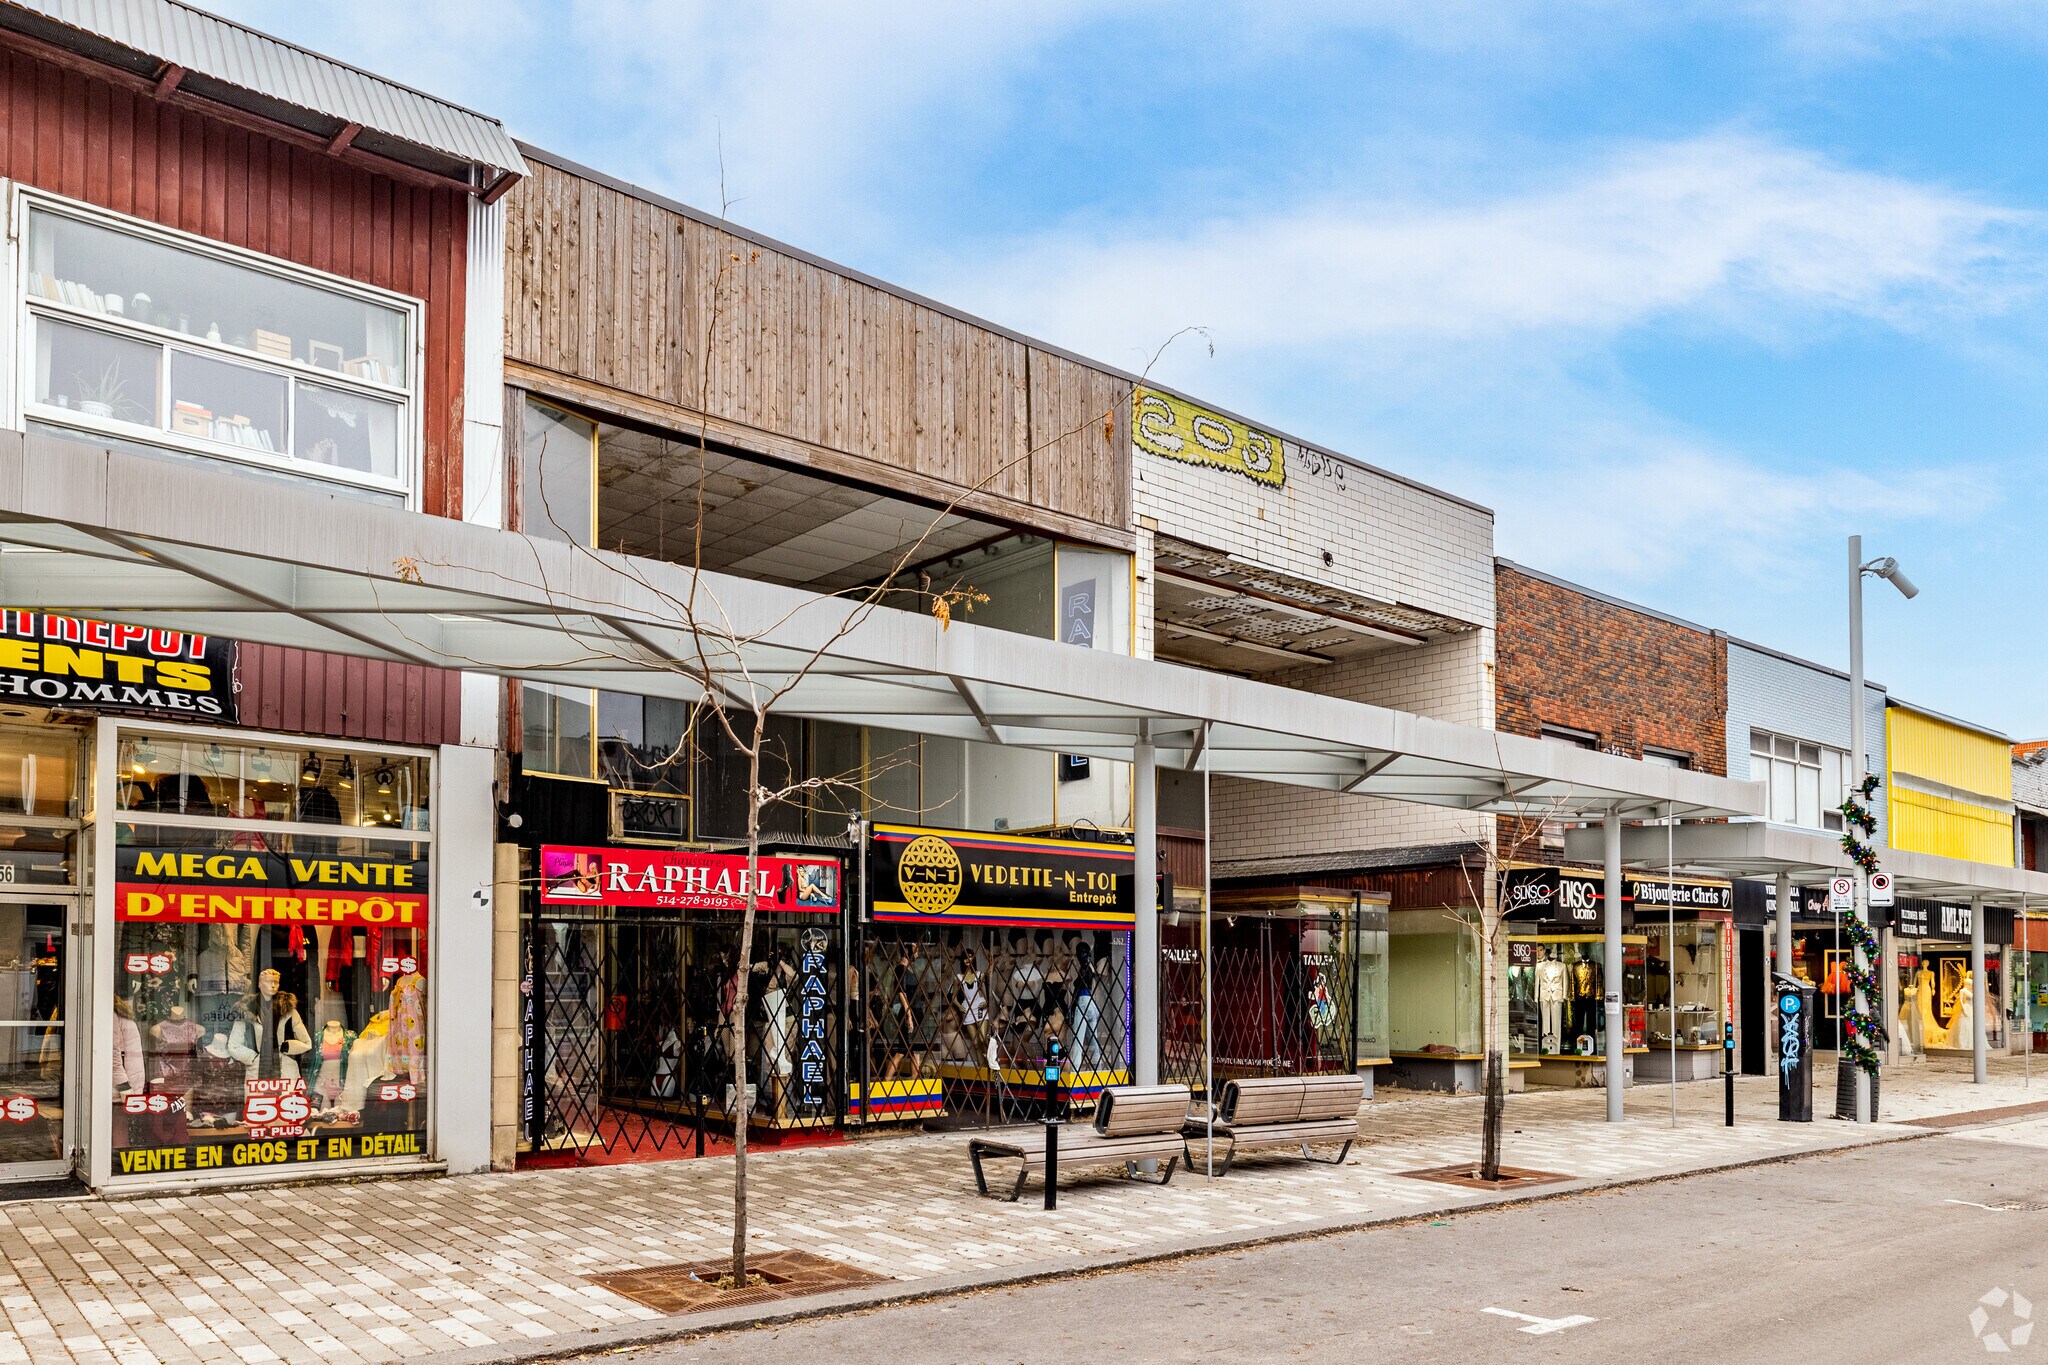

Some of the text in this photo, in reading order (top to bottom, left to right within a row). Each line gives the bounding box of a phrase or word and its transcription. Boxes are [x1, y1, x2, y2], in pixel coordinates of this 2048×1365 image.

[0, 673, 224, 715] HOMMES
[135, 851, 413, 887] MEGA VENTE
[662, 853, 727, 868] Chaussures
[606, 862, 776, 898] RAPHAEL
[903, 866, 957, 883] V-N-T
[970, 863, 1117, 891] VEDETTE-N-TOI
[656, 894, 729, 907] 514-278-9195
[1069, 890, 1117, 906] Entrepôt
[1559, 880, 1597, 908] ENSO
[1692, 887, 1719, 904] Chris
[127, 892, 420, 923] D'ENTREPÔT
[127, 954, 171, 974] 5$
[382, 956, 418, 974] 5$
[801, 952, 827, 1105] RAPHAEL
[248, 1079, 289, 1092] TOUT
[380, 1084, 417, 1102] 5$
[125, 1094, 169, 1113] 5$
[246, 1094, 309, 1124] 5$
[251, 1125, 303, 1137] ET PLUS
[120, 1131, 419, 1173] VENTE EN GROS ET EN DÉTAIL
